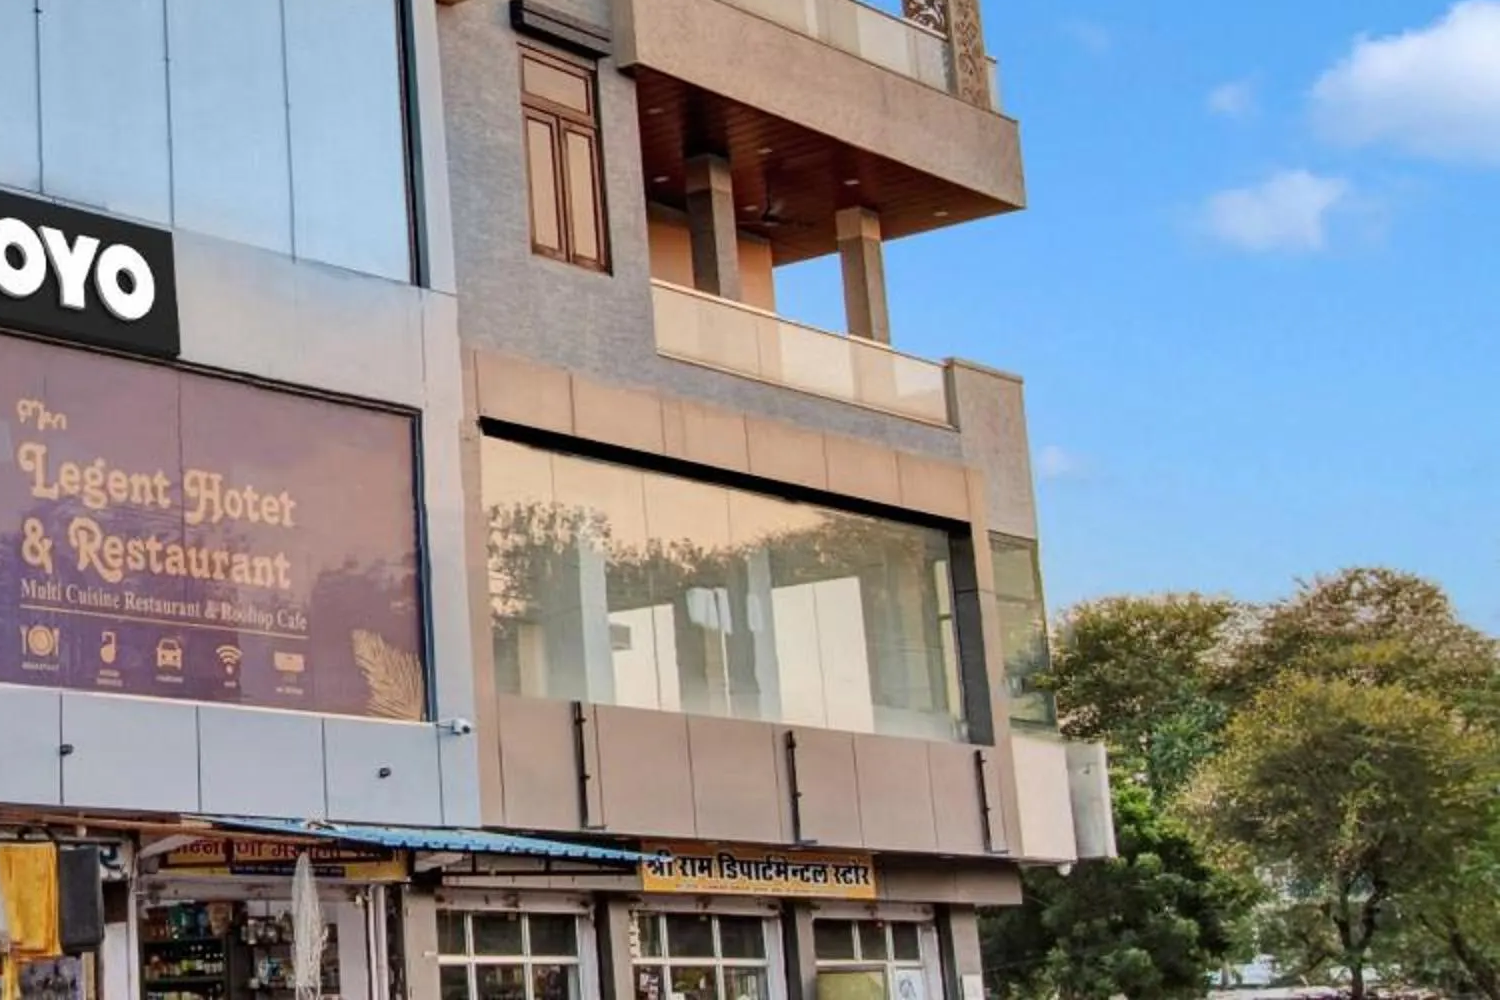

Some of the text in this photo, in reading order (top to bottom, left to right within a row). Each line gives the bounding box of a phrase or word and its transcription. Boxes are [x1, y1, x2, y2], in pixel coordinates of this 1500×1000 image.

[22, 516, 292, 590] & Restaurant
[20, 578, 62, 601] Multi
[65, 584, 120, 608] Cuisine
[124, 591, 200, 618] Restaurant
[204, 600, 221, 619] &
[276, 608, 308, 631] Cafe
[674, 856, 713, 878] राम
